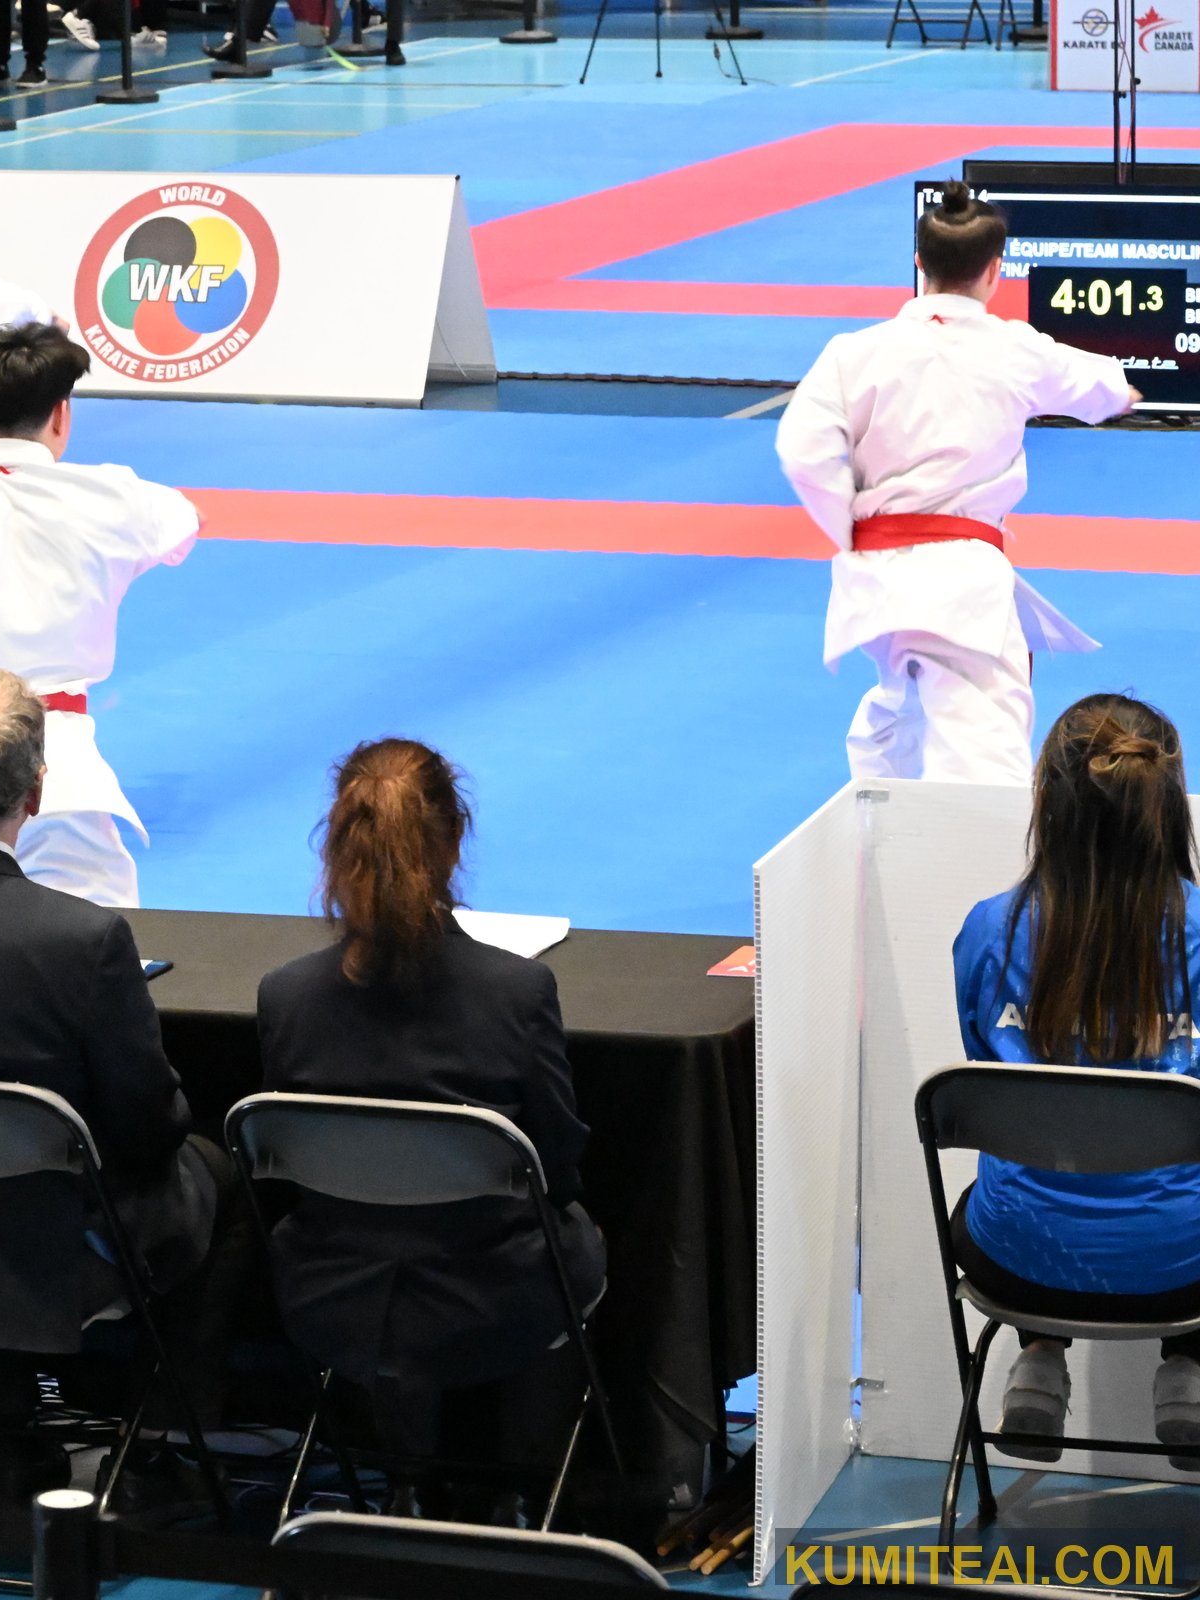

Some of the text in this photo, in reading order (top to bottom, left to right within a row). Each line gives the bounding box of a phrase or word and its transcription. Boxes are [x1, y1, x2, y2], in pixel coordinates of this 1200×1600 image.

[1063, 40, 1107, 49] KARATE
[1154, 32, 1193, 41] KARATE
[1154, 42, 1194, 51] CANADA
[159, 185, 227, 206] WORLD
[1000, 262, 1038, 278] FINA
[128, 263, 225, 303] WKF
[84, 324, 251, 380] KARATE FEDERATION
